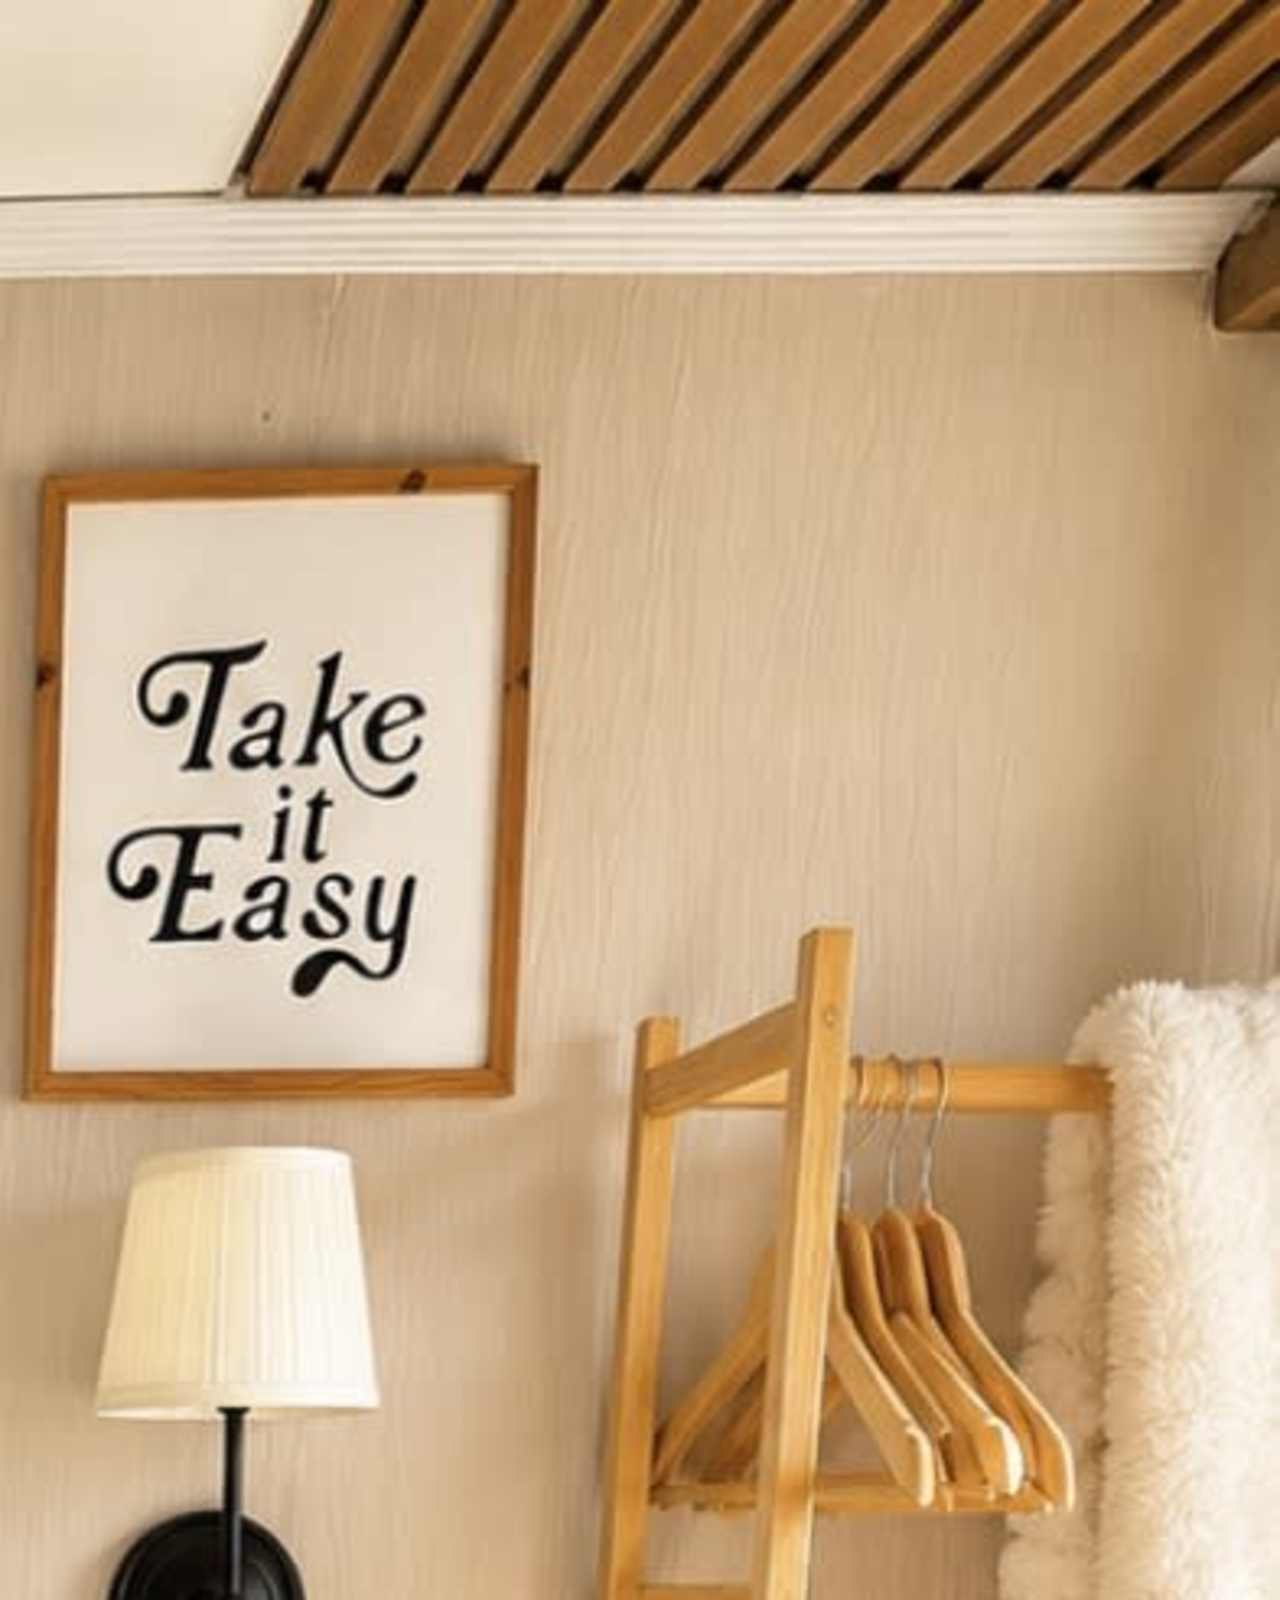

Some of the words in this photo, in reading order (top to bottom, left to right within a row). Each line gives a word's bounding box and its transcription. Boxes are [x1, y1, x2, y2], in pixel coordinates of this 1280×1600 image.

[137, 640, 427, 798] Take
[266, 784, 334, 863] it
[105, 823, 417, 997] Easy
